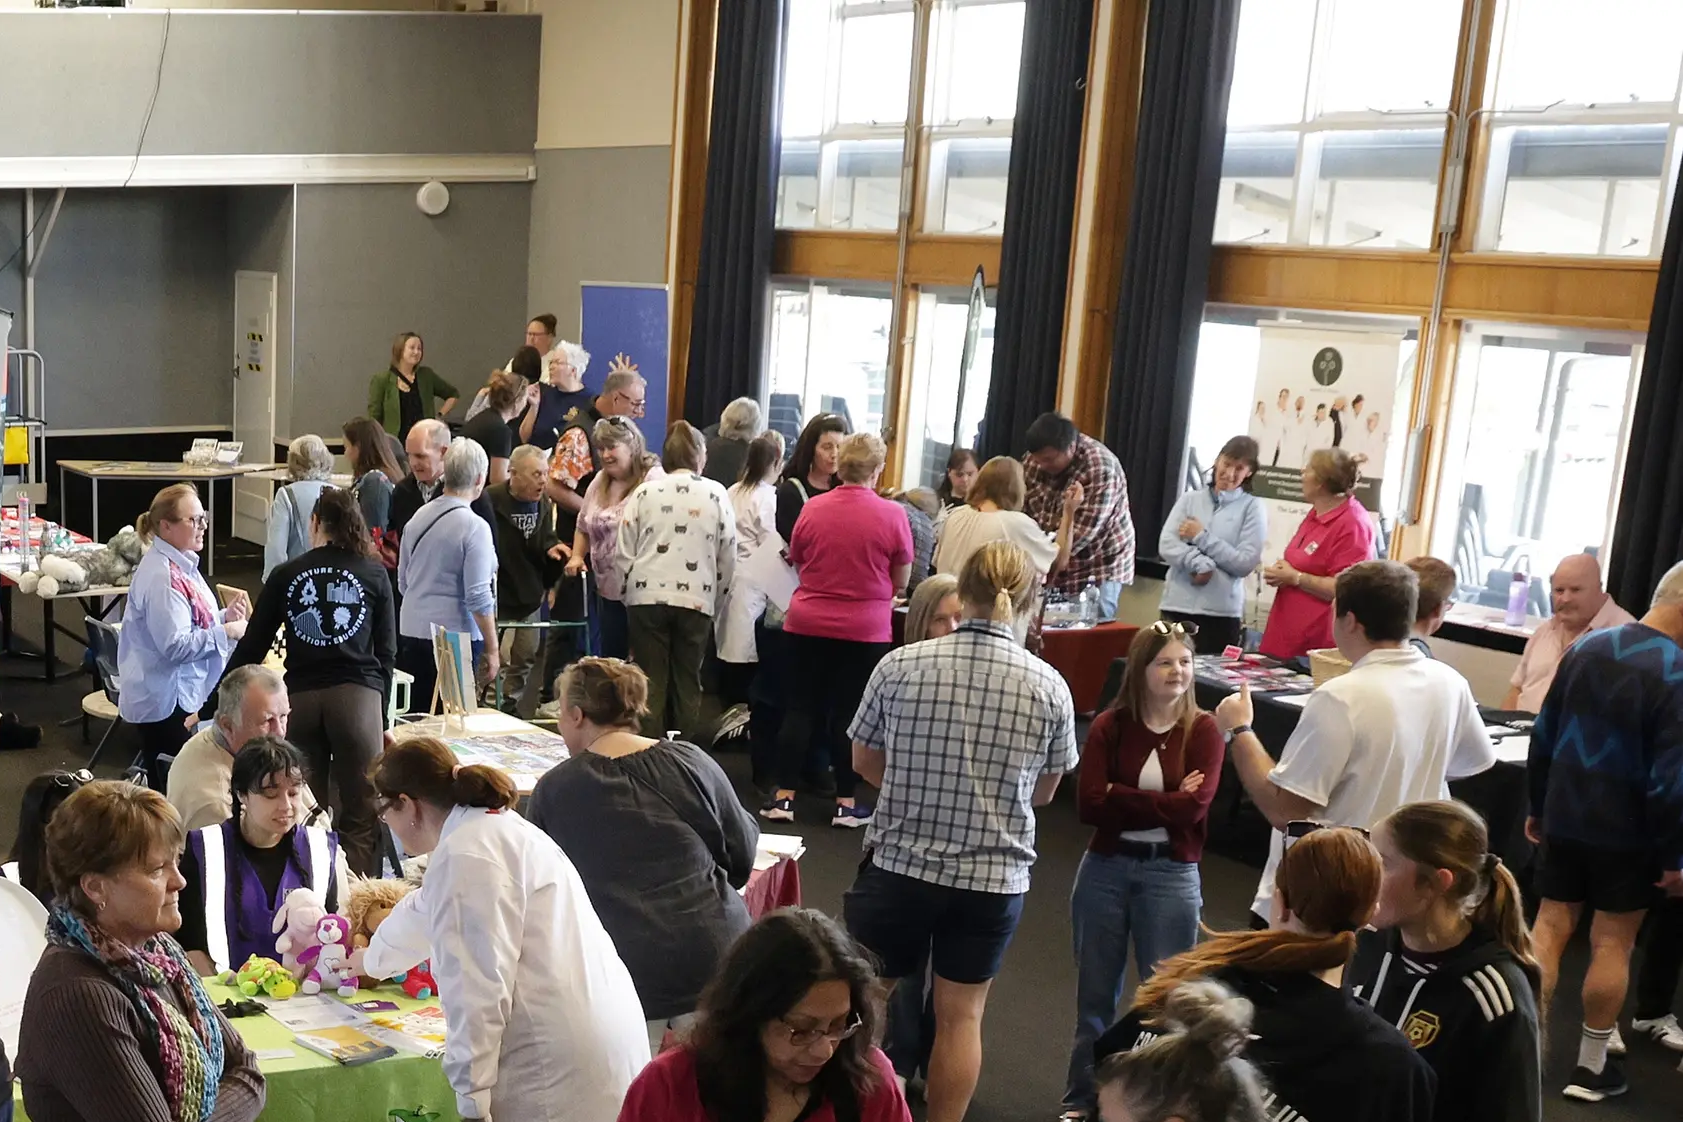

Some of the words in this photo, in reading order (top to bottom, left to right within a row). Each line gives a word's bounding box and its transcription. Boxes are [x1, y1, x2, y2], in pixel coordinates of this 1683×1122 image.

[287, 567, 333, 598] ADVENTURE
[342, 569, 365, 599] SOCIAL
[333, 606, 367, 645] EDUCATION
